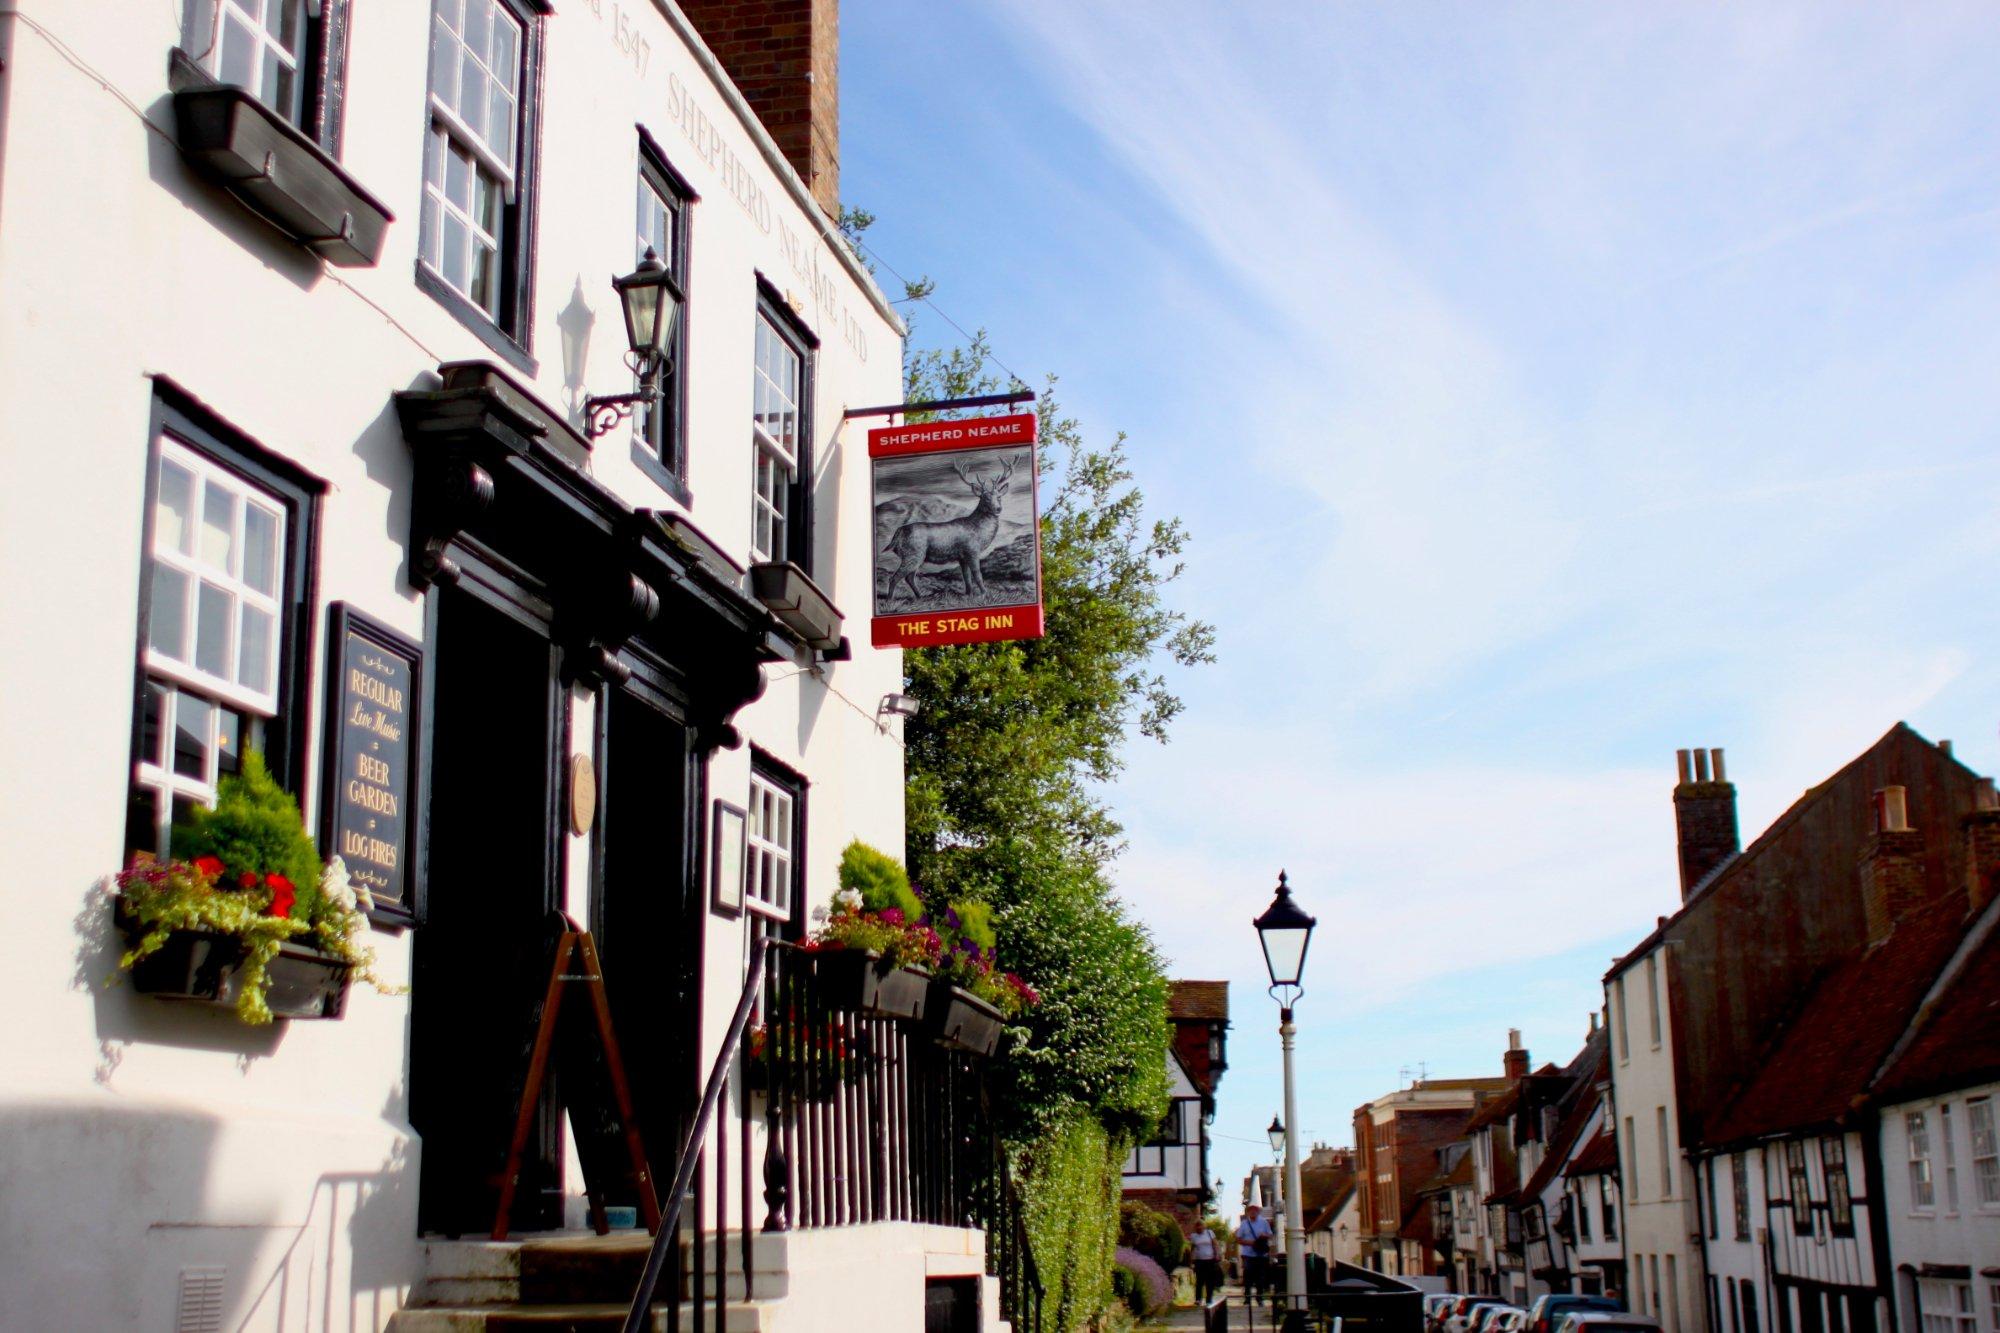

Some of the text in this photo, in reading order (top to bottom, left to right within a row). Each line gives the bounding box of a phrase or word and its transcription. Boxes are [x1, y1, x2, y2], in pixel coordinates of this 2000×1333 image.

[612, 3, 867, 363] 1547 SHEPHERD NEAME LTD
[880, 423, 1021, 446] SHEPHERD NEAME
[898, 614, 1014, 636] THE STAG INN
[352, 668, 403, 713] REGULAR
[350, 701, 401, 742] Live Music
[359, 752, 390, 787] BEER
[350, 780, 397, 817] GARDEN
[346, 829, 397, 869] LOG FIRES
